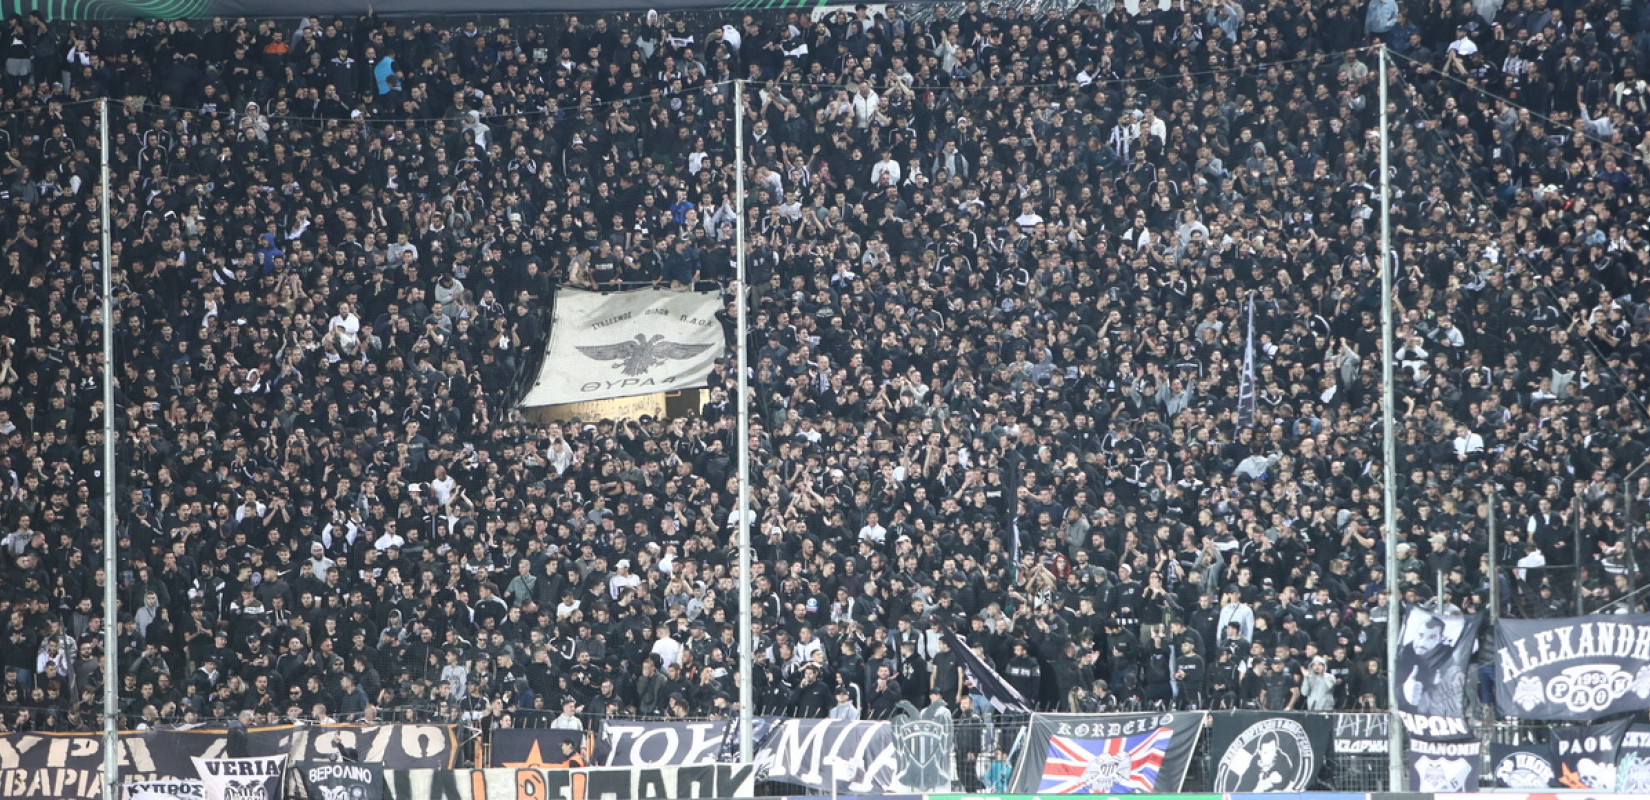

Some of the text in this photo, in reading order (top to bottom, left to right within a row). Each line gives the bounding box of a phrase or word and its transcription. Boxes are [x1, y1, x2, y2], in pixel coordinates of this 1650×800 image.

[580, 378, 656, 392] ΘΥΡΑ
[1056, 713, 1174, 738] KORDELIO
[205, 760, 281, 776] VERIA
[309, 764, 372, 784] ΒΕΡΟΛΙΝΟ
